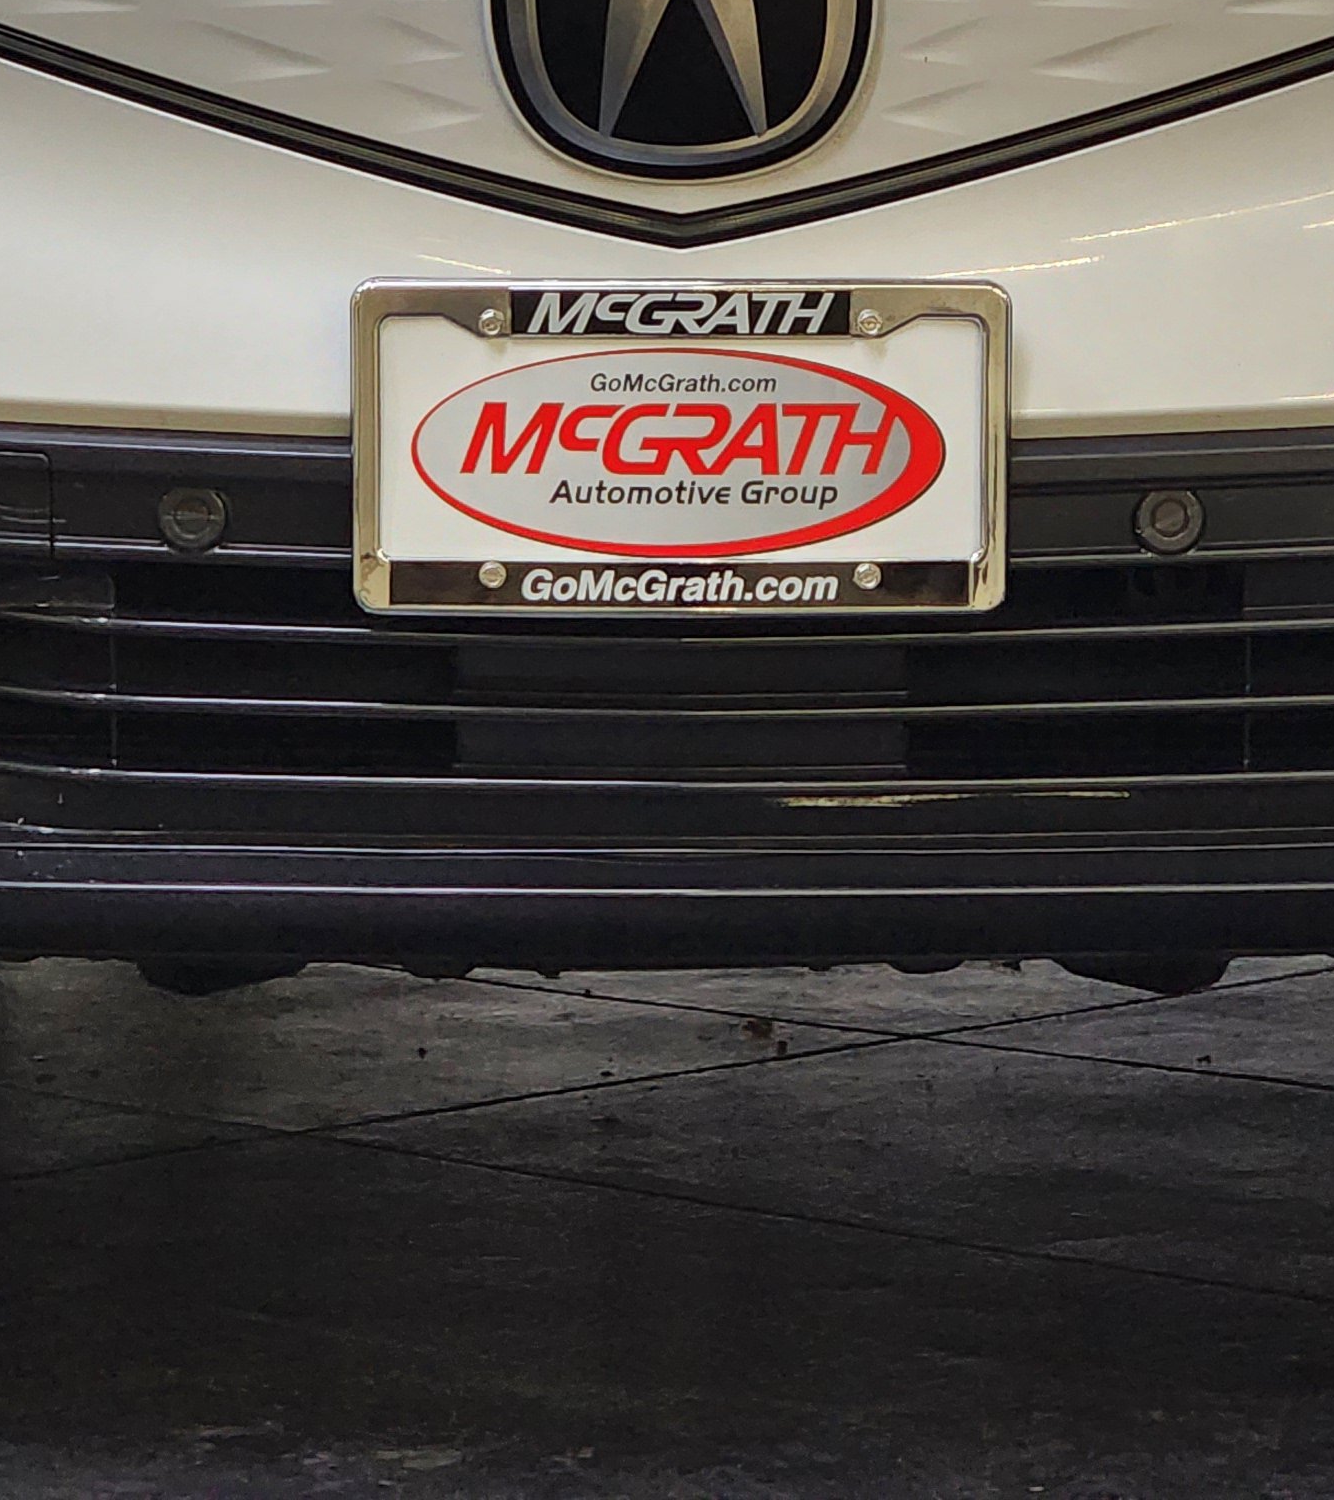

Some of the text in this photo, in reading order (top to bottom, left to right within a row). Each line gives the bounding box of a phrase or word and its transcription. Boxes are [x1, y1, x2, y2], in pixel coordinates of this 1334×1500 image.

[589, 372, 777, 395] GoMcGrath.com
[550, 479, 839, 510] Automotive Group
[521, 568, 838, 602] GoMcGrath.com
